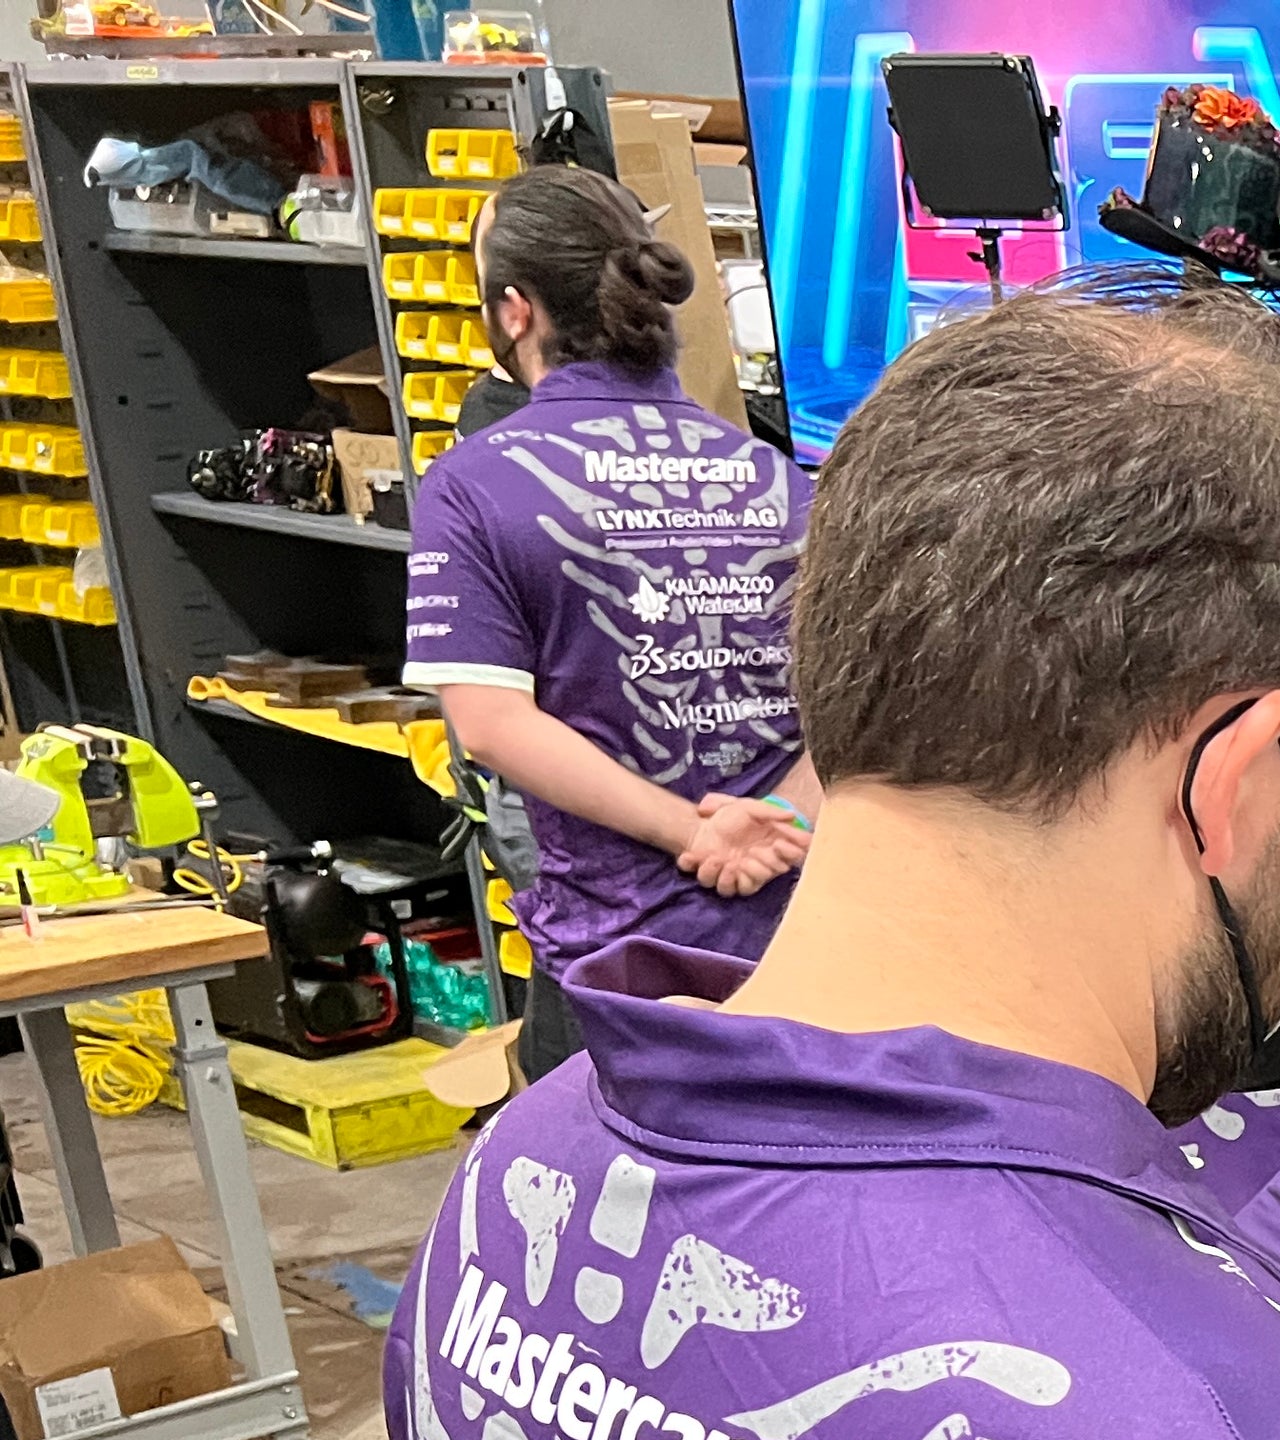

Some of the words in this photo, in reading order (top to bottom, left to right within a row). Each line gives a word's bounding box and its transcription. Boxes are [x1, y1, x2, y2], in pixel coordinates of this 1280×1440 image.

[584, 449, 757, 483] Mastercam
[742, 508, 779, 528] AG
[665, 575, 775, 596] KALAMAZOO
